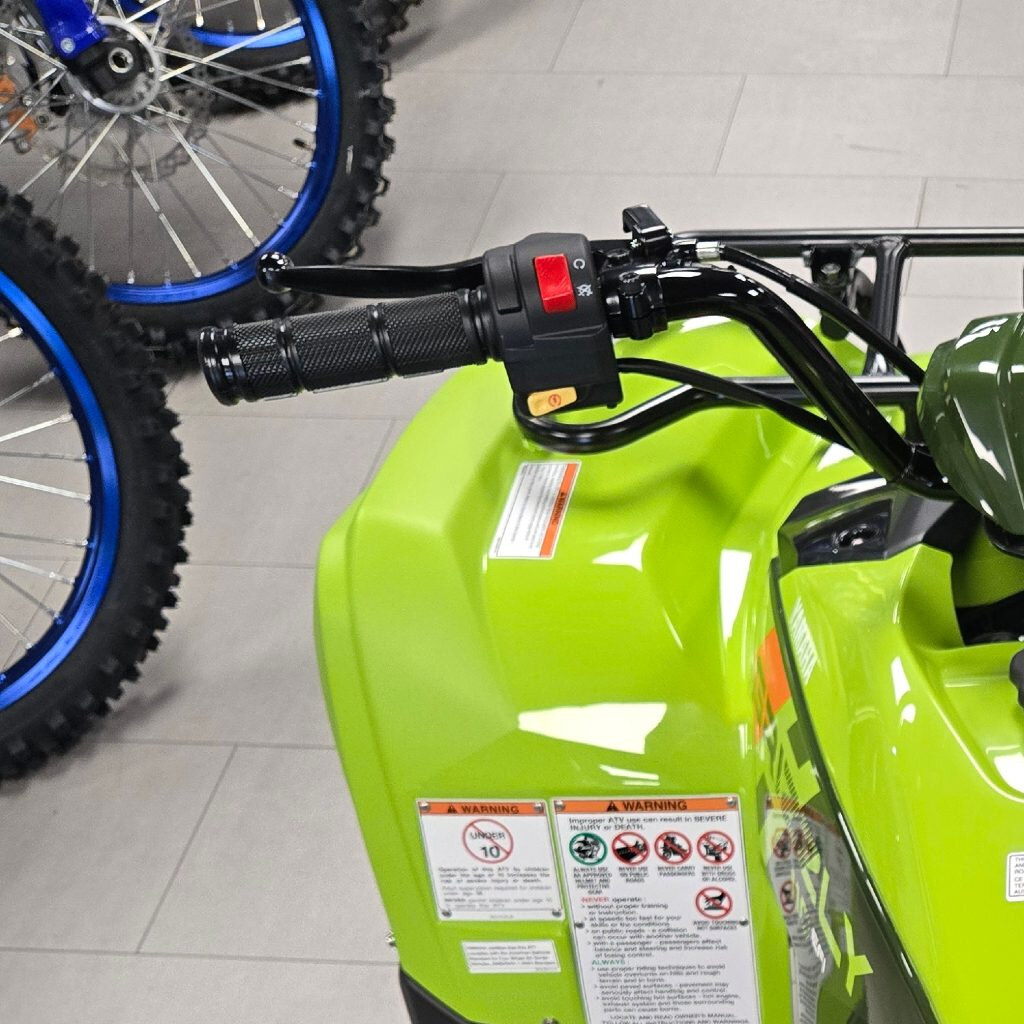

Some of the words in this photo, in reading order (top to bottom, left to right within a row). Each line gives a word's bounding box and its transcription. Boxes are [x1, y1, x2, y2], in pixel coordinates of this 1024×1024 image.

[461, 805, 519, 813] WARNING
[622, 800, 687, 811] WARNING
[469, 831, 505, 840] UNDER
[480, 846, 501, 857] 10
